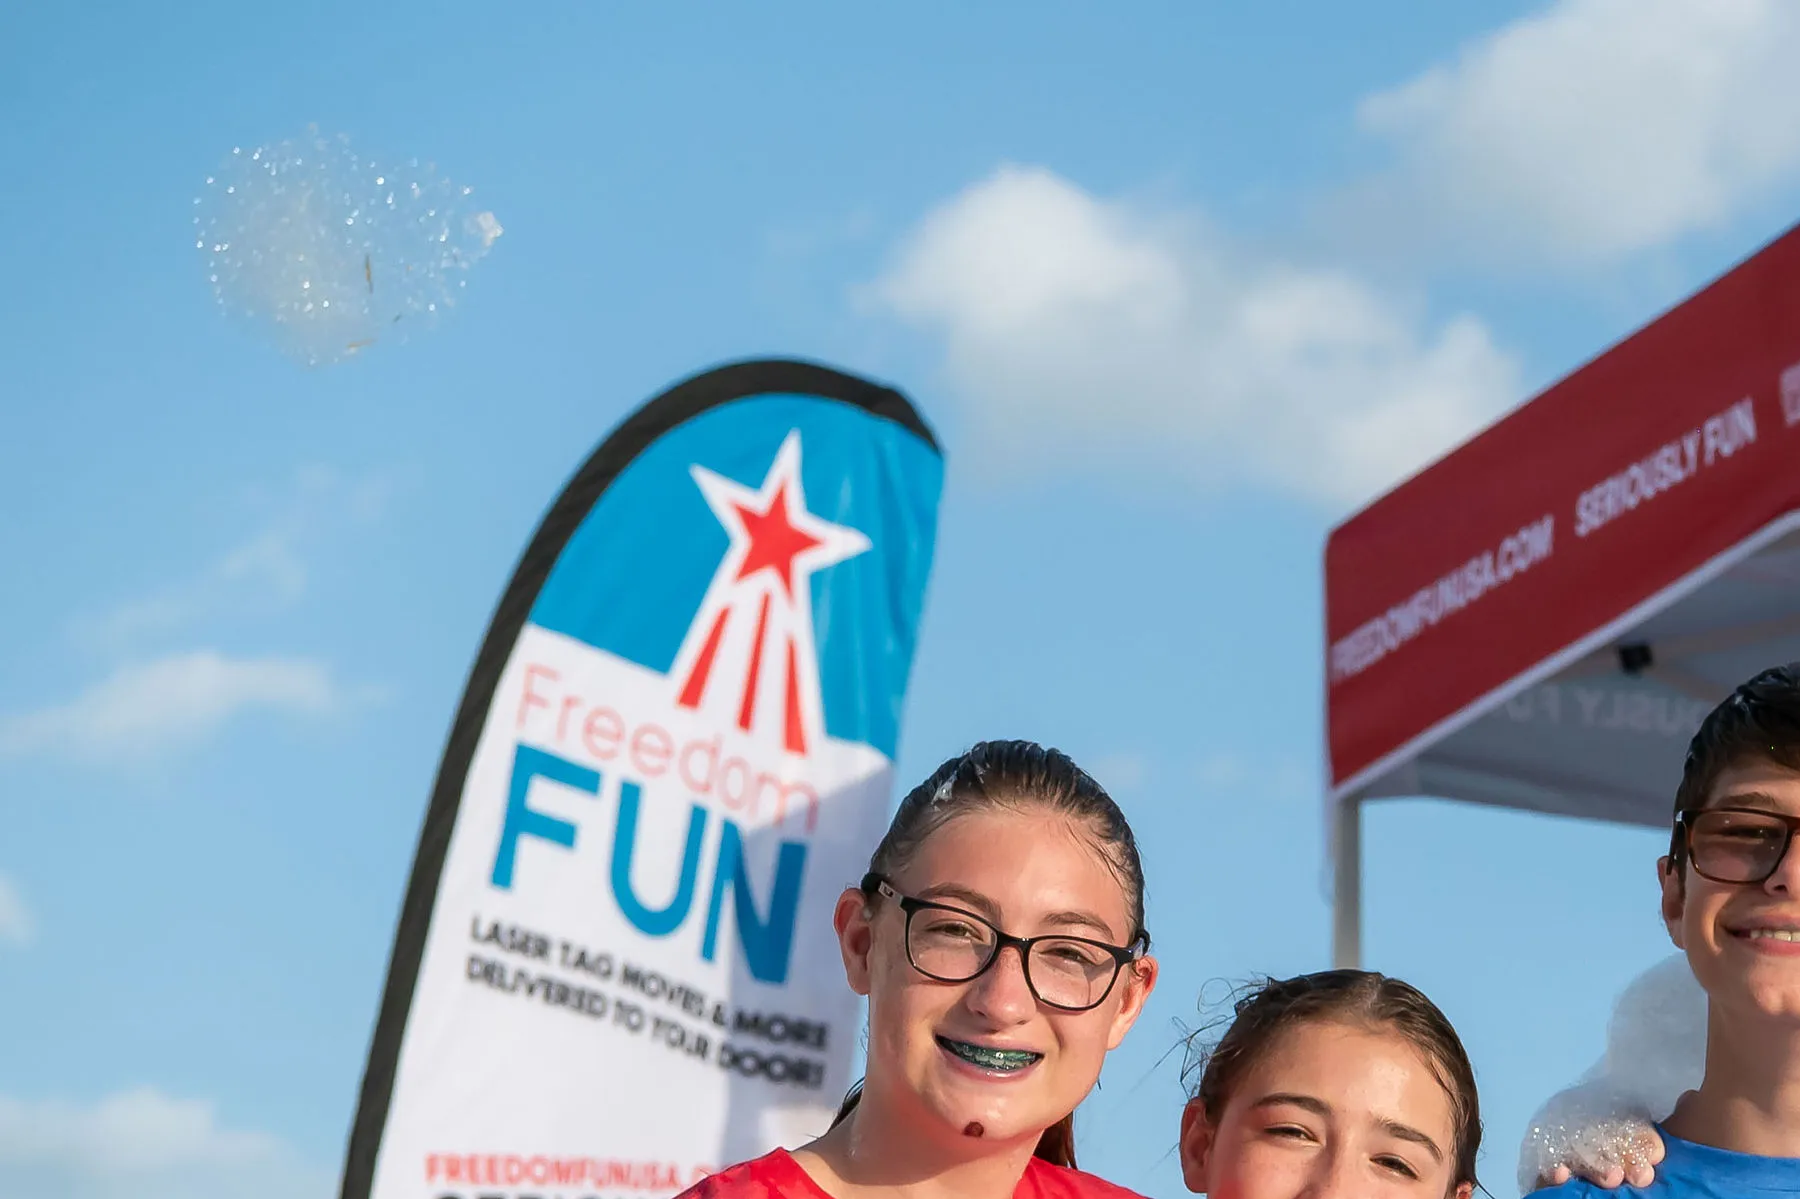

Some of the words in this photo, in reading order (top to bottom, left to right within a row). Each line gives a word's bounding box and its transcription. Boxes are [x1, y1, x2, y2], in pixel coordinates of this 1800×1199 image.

[1574, 431, 1698, 538] SERIOUSLY
[1703, 397, 1757, 466] FUN
[515, 663, 820, 834] Freedom
[490, 742, 808, 986] FUN
[466, 955, 606, 1020] DELIVERED
[613, 1000, 645, 1033] TO
[651, 1018, 710, 1060] YOUR
[470, 916, 552, 956] LASER
[560, 943, 613, 980] TAG
[732, 1007, 830, 1050] MORE
